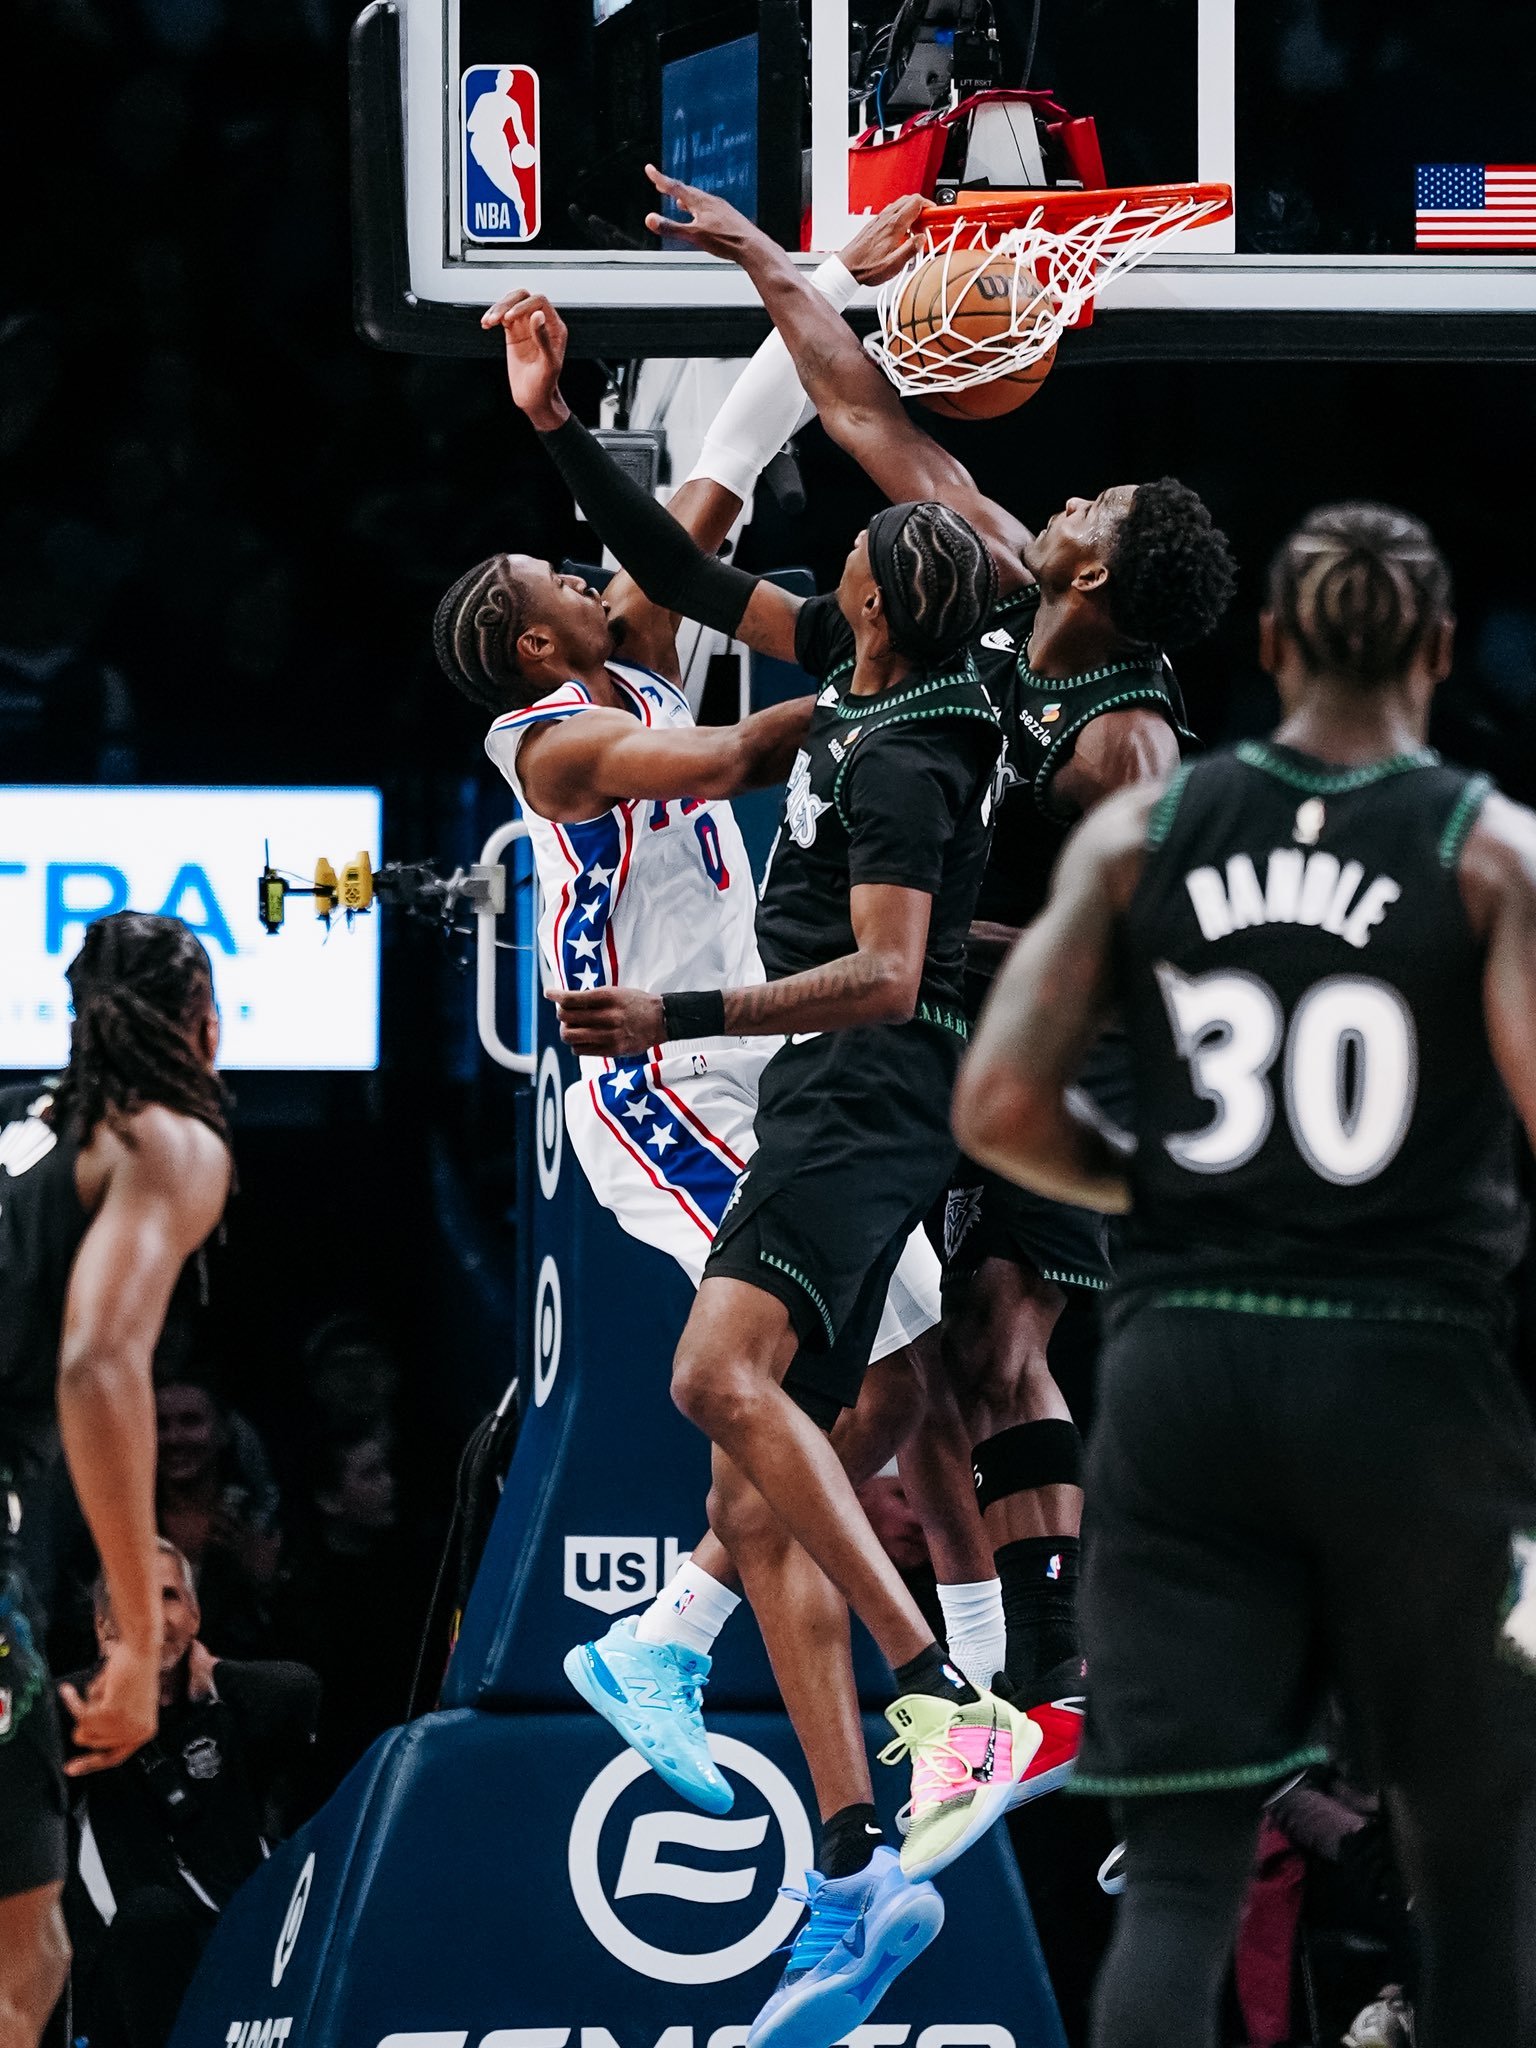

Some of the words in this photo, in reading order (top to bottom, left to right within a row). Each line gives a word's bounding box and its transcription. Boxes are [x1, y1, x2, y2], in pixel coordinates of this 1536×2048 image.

[475, 202, 511, 230] NBA
[1019, 708, 1052, 747] sezzle
[694, 811, 730, 891] 0
[1154, 960, 1418, 1186] 30
